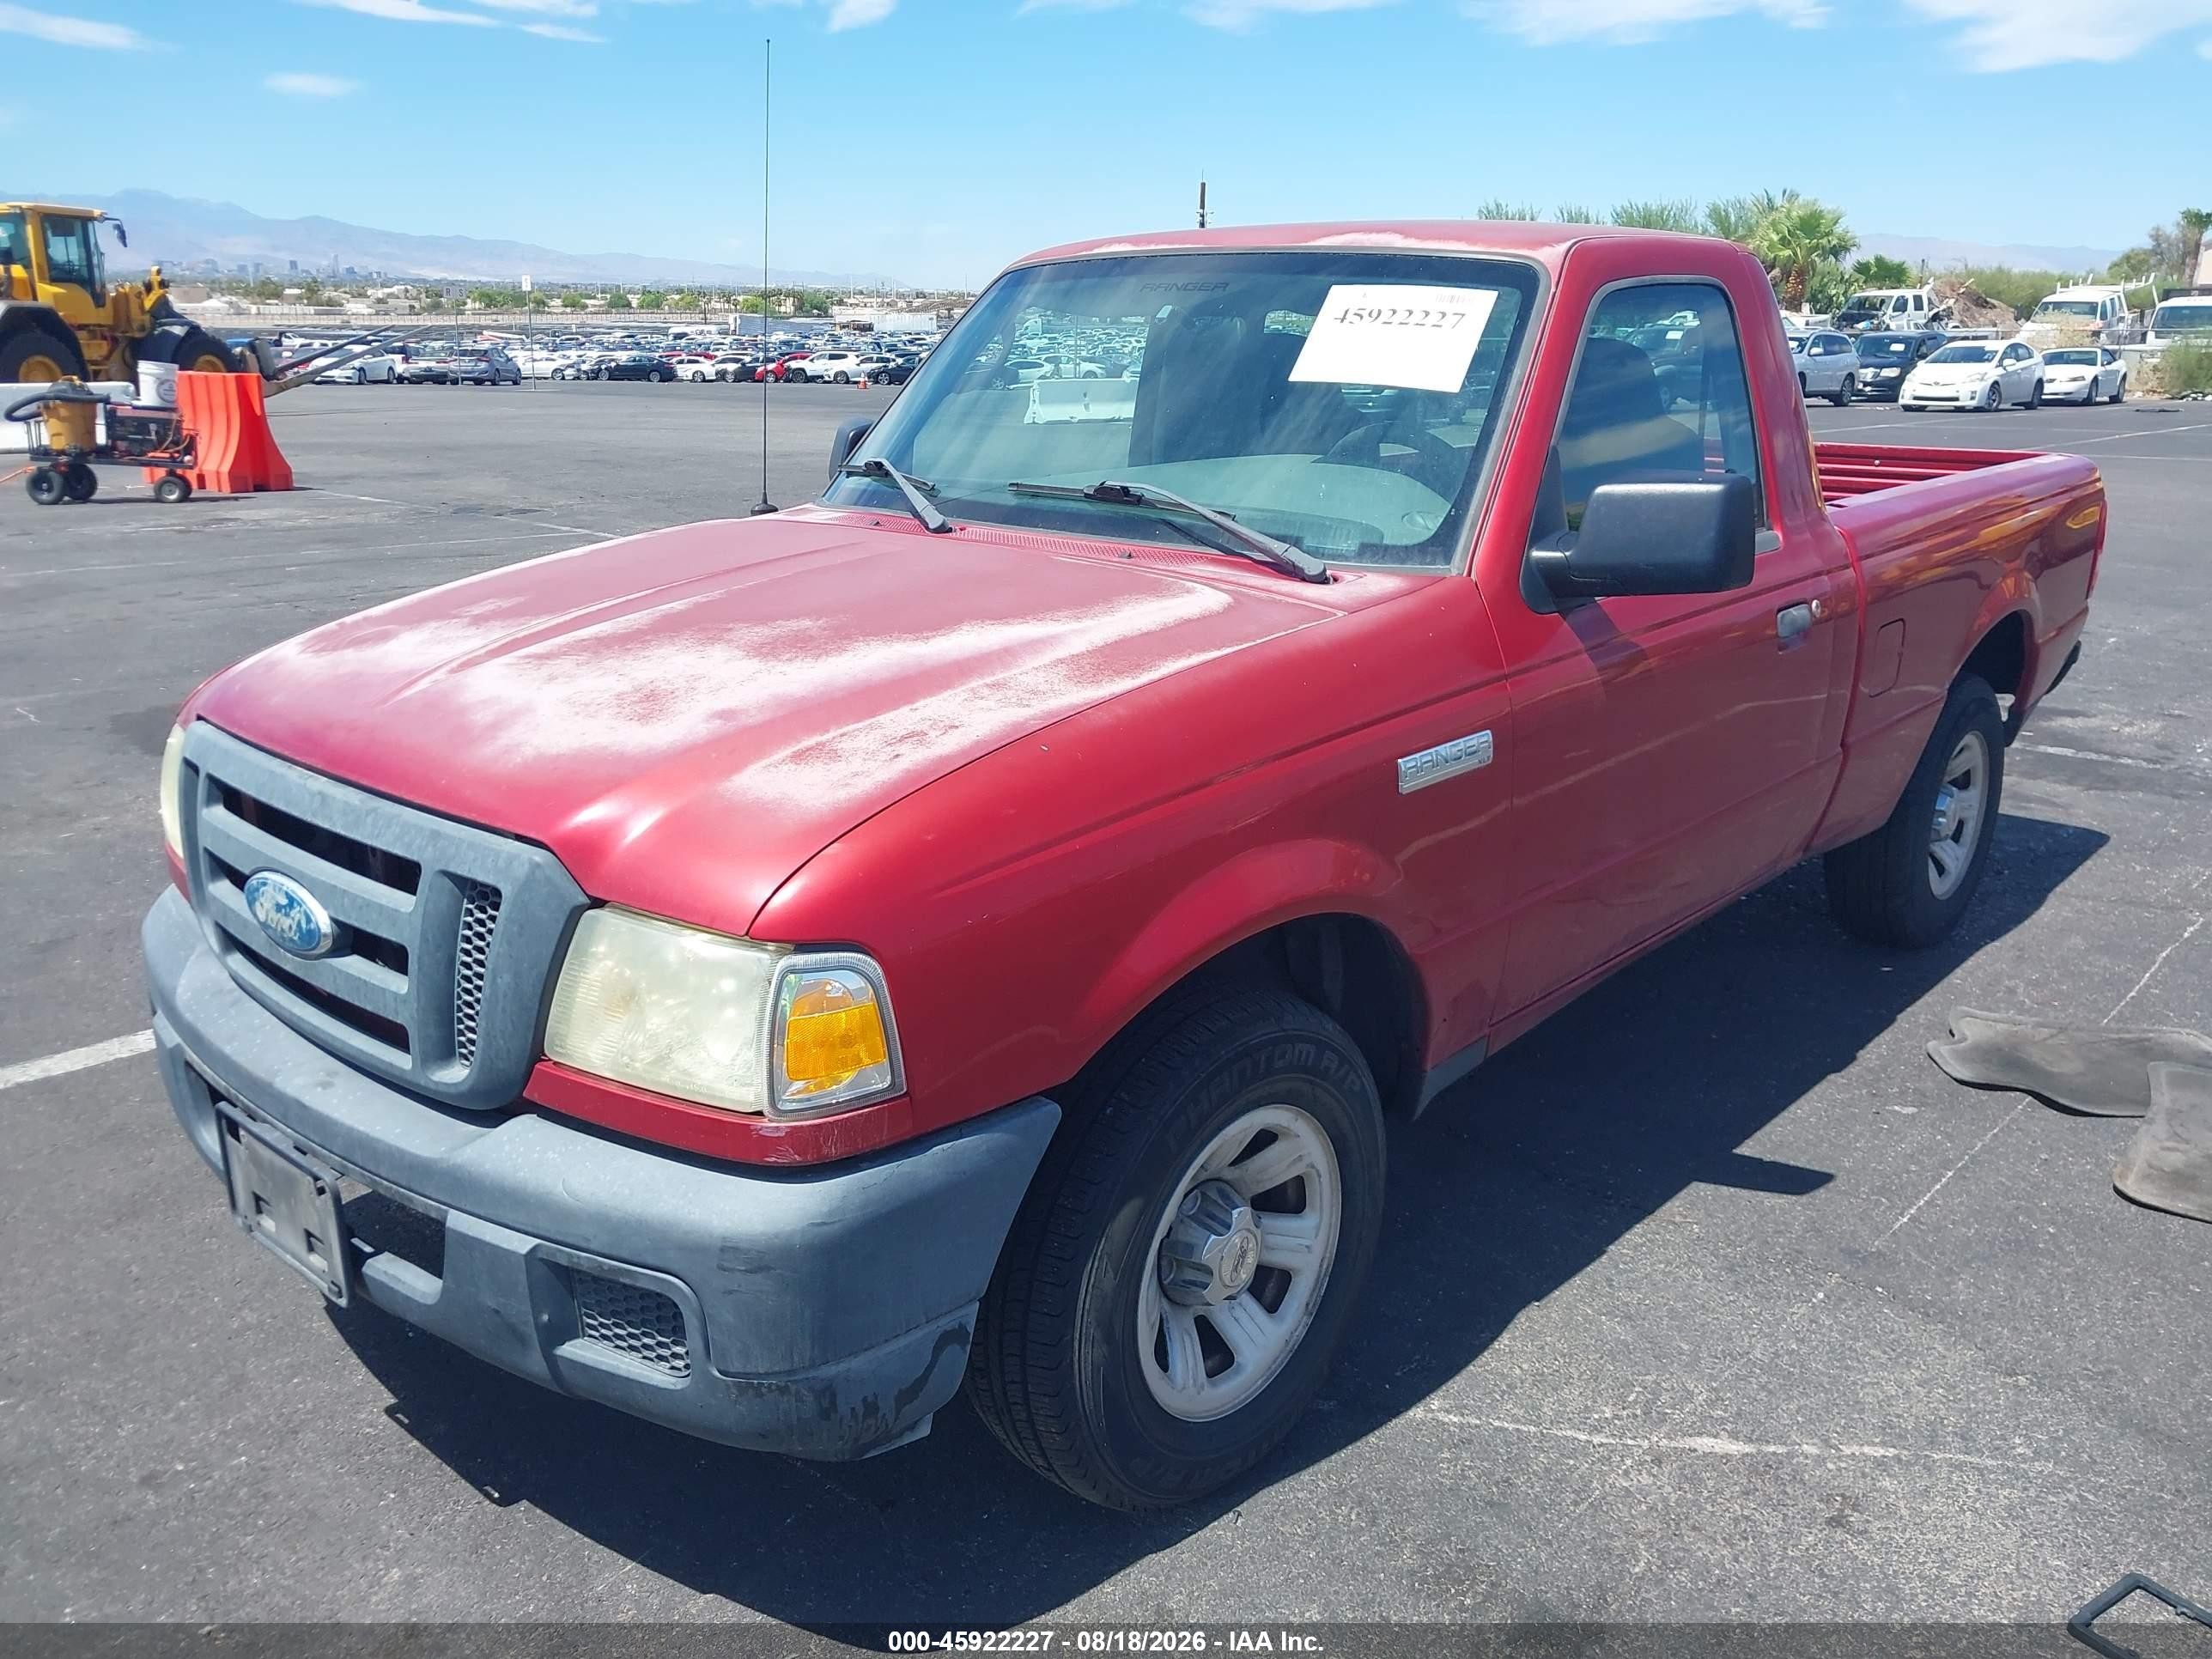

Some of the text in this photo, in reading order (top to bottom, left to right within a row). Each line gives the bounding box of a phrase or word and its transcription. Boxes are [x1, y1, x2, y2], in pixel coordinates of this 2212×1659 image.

[1139, 282, 1230, 293] RANGER
[1334, 307, 1467, 330] 45922227
[1401, 732, 1492, 780] RANGER
